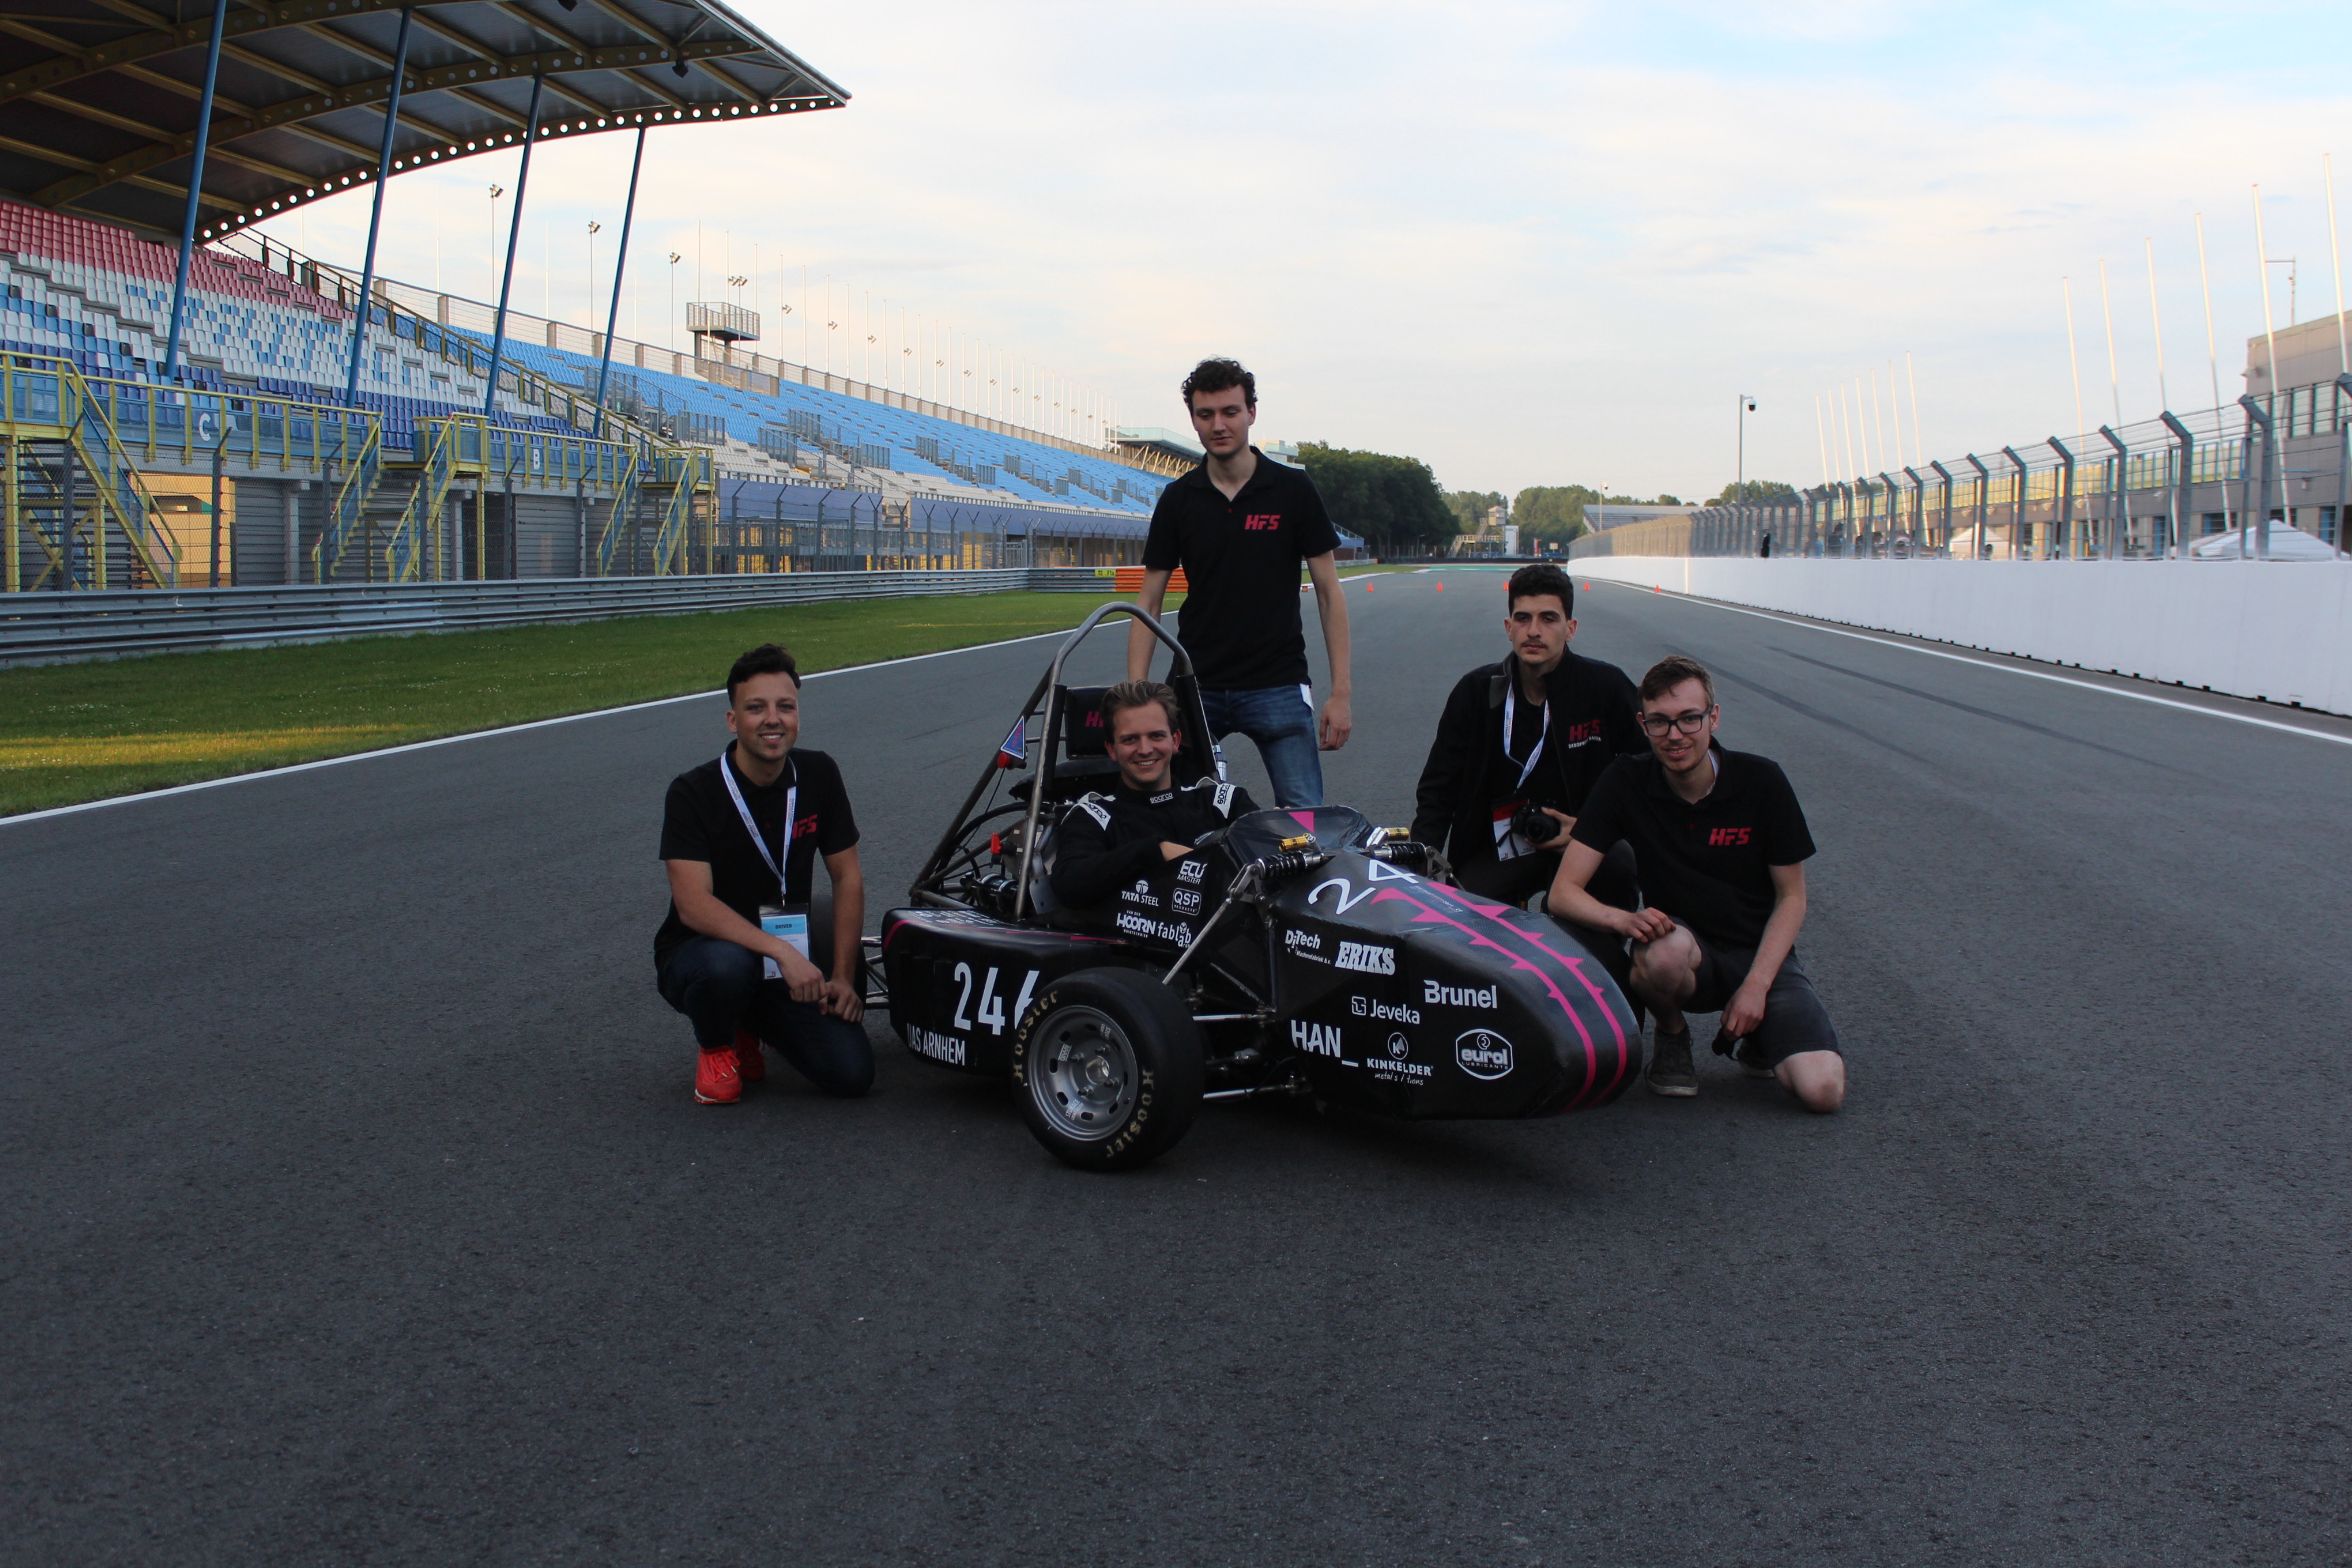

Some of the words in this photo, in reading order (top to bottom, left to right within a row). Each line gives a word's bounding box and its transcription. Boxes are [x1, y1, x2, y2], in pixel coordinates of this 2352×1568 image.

[199, 413, 211, 442] C
[534, 449, 540, 470] B
[1245, 514, 1282, 530] HFS
[1569, 719, 1601, 742] HFS
[1150, 793, 1174, 804] sparco
[1709, 828, 1752, 846] HFS
[1179, 860, 1207, 879] ECU
[1177, 875, 1200, 885] MASTER
[1308, 860, 1419, 915] 24
[1122, 891, 1140, 902] TATA
[1141, 894, 1159, 906] STEEL
[1174, 892, 1200, 906] QSP
[1117, 913, 1156, 935] HOORN
[1335, 941, 1395, 975] ERIKS
[1424, 980, 1497, 1009] Brunel
[1370, 999, 1420, 1024] Jeveka
[906, 1023, 920, 1053] UAS
[924, 1029, 966, 1066] ARNHEM
[1461, 1049, 1508, 1066] eurol
[1461, 1062, 1508, 1070] LUBRICANTS
[1367, 1058, 1432, 1077] KINKELDER
[1375, 1071, 1394, 1080] metal
